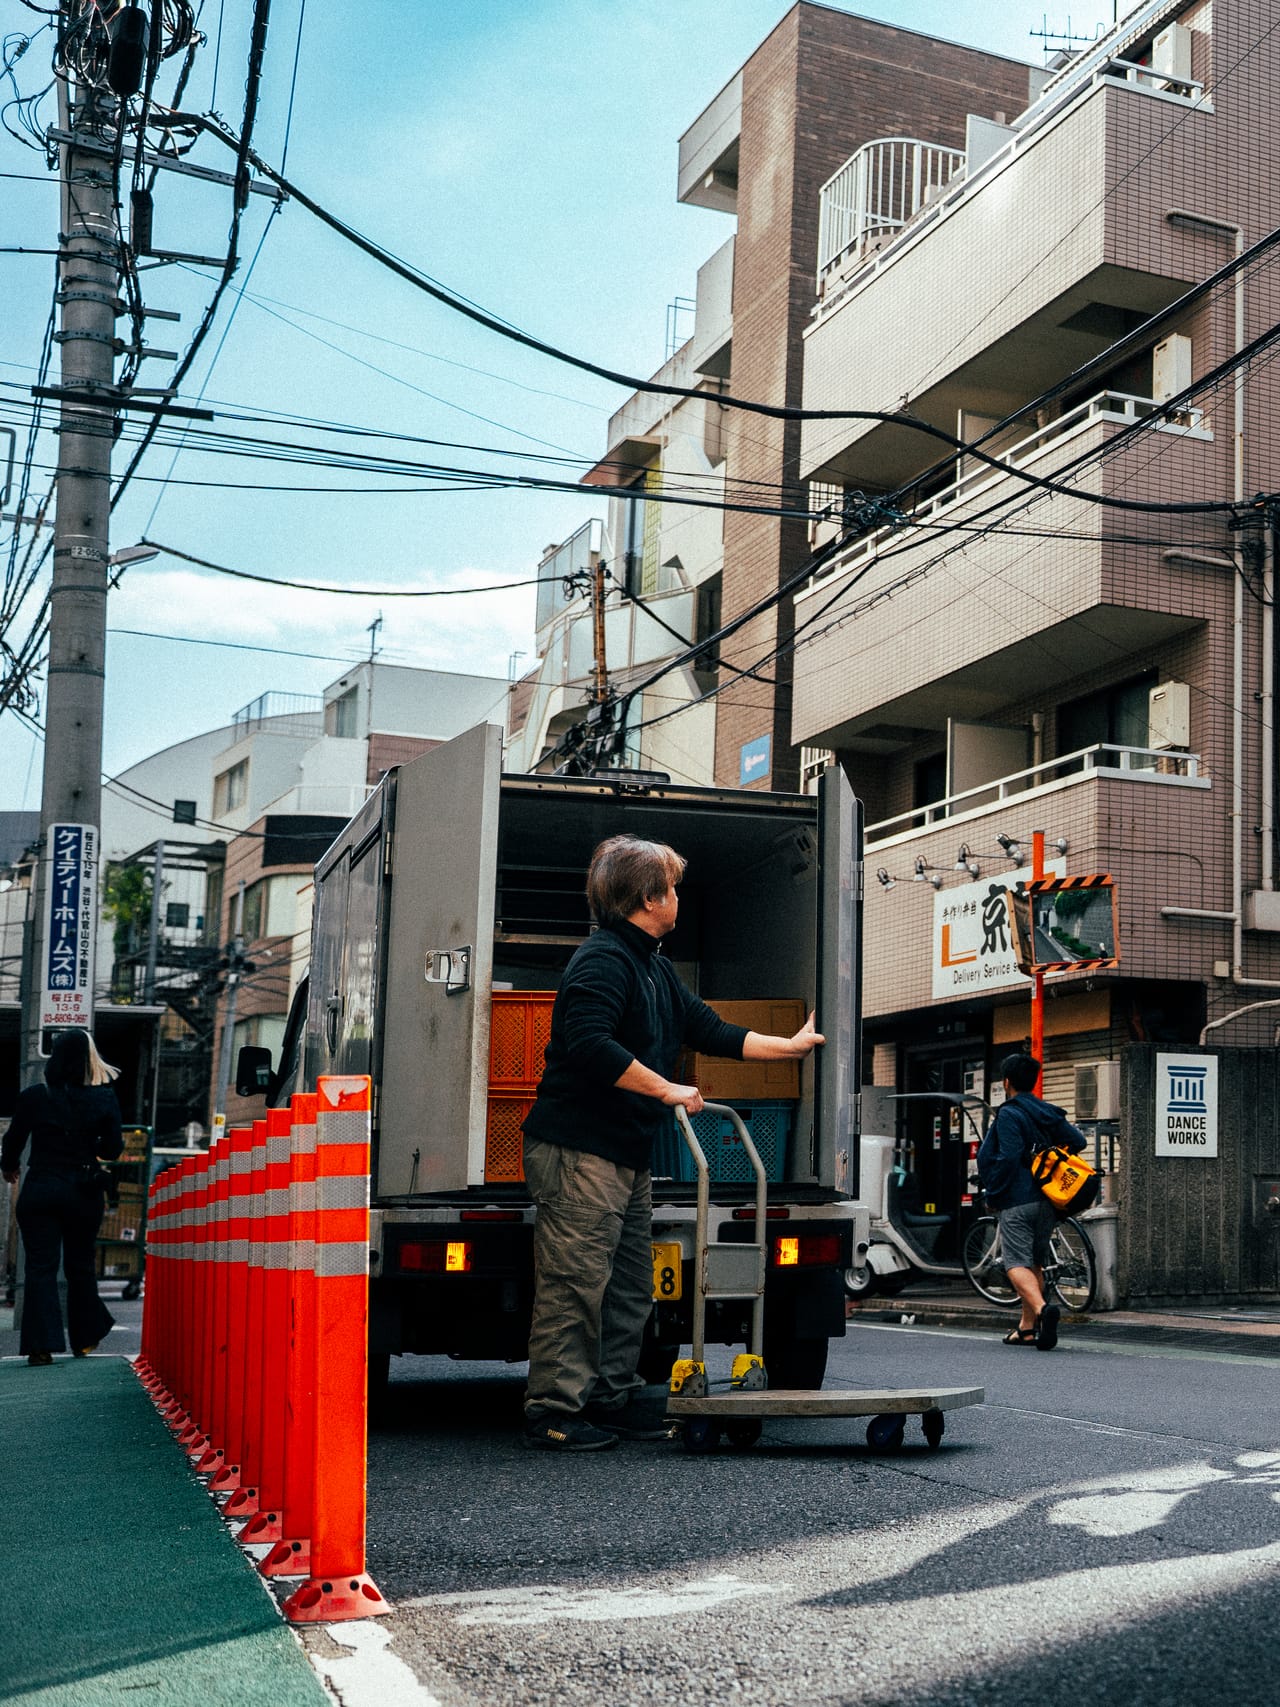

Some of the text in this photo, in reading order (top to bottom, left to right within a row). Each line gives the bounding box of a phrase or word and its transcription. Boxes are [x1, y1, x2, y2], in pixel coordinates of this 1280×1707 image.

[953, 969, 980, 984] Delivery
[984, 963, 1010, 978] Service
[1167, 1116, 1206, 1130] DANCE
[1167, 1131, 1206, 1145] WORKS
